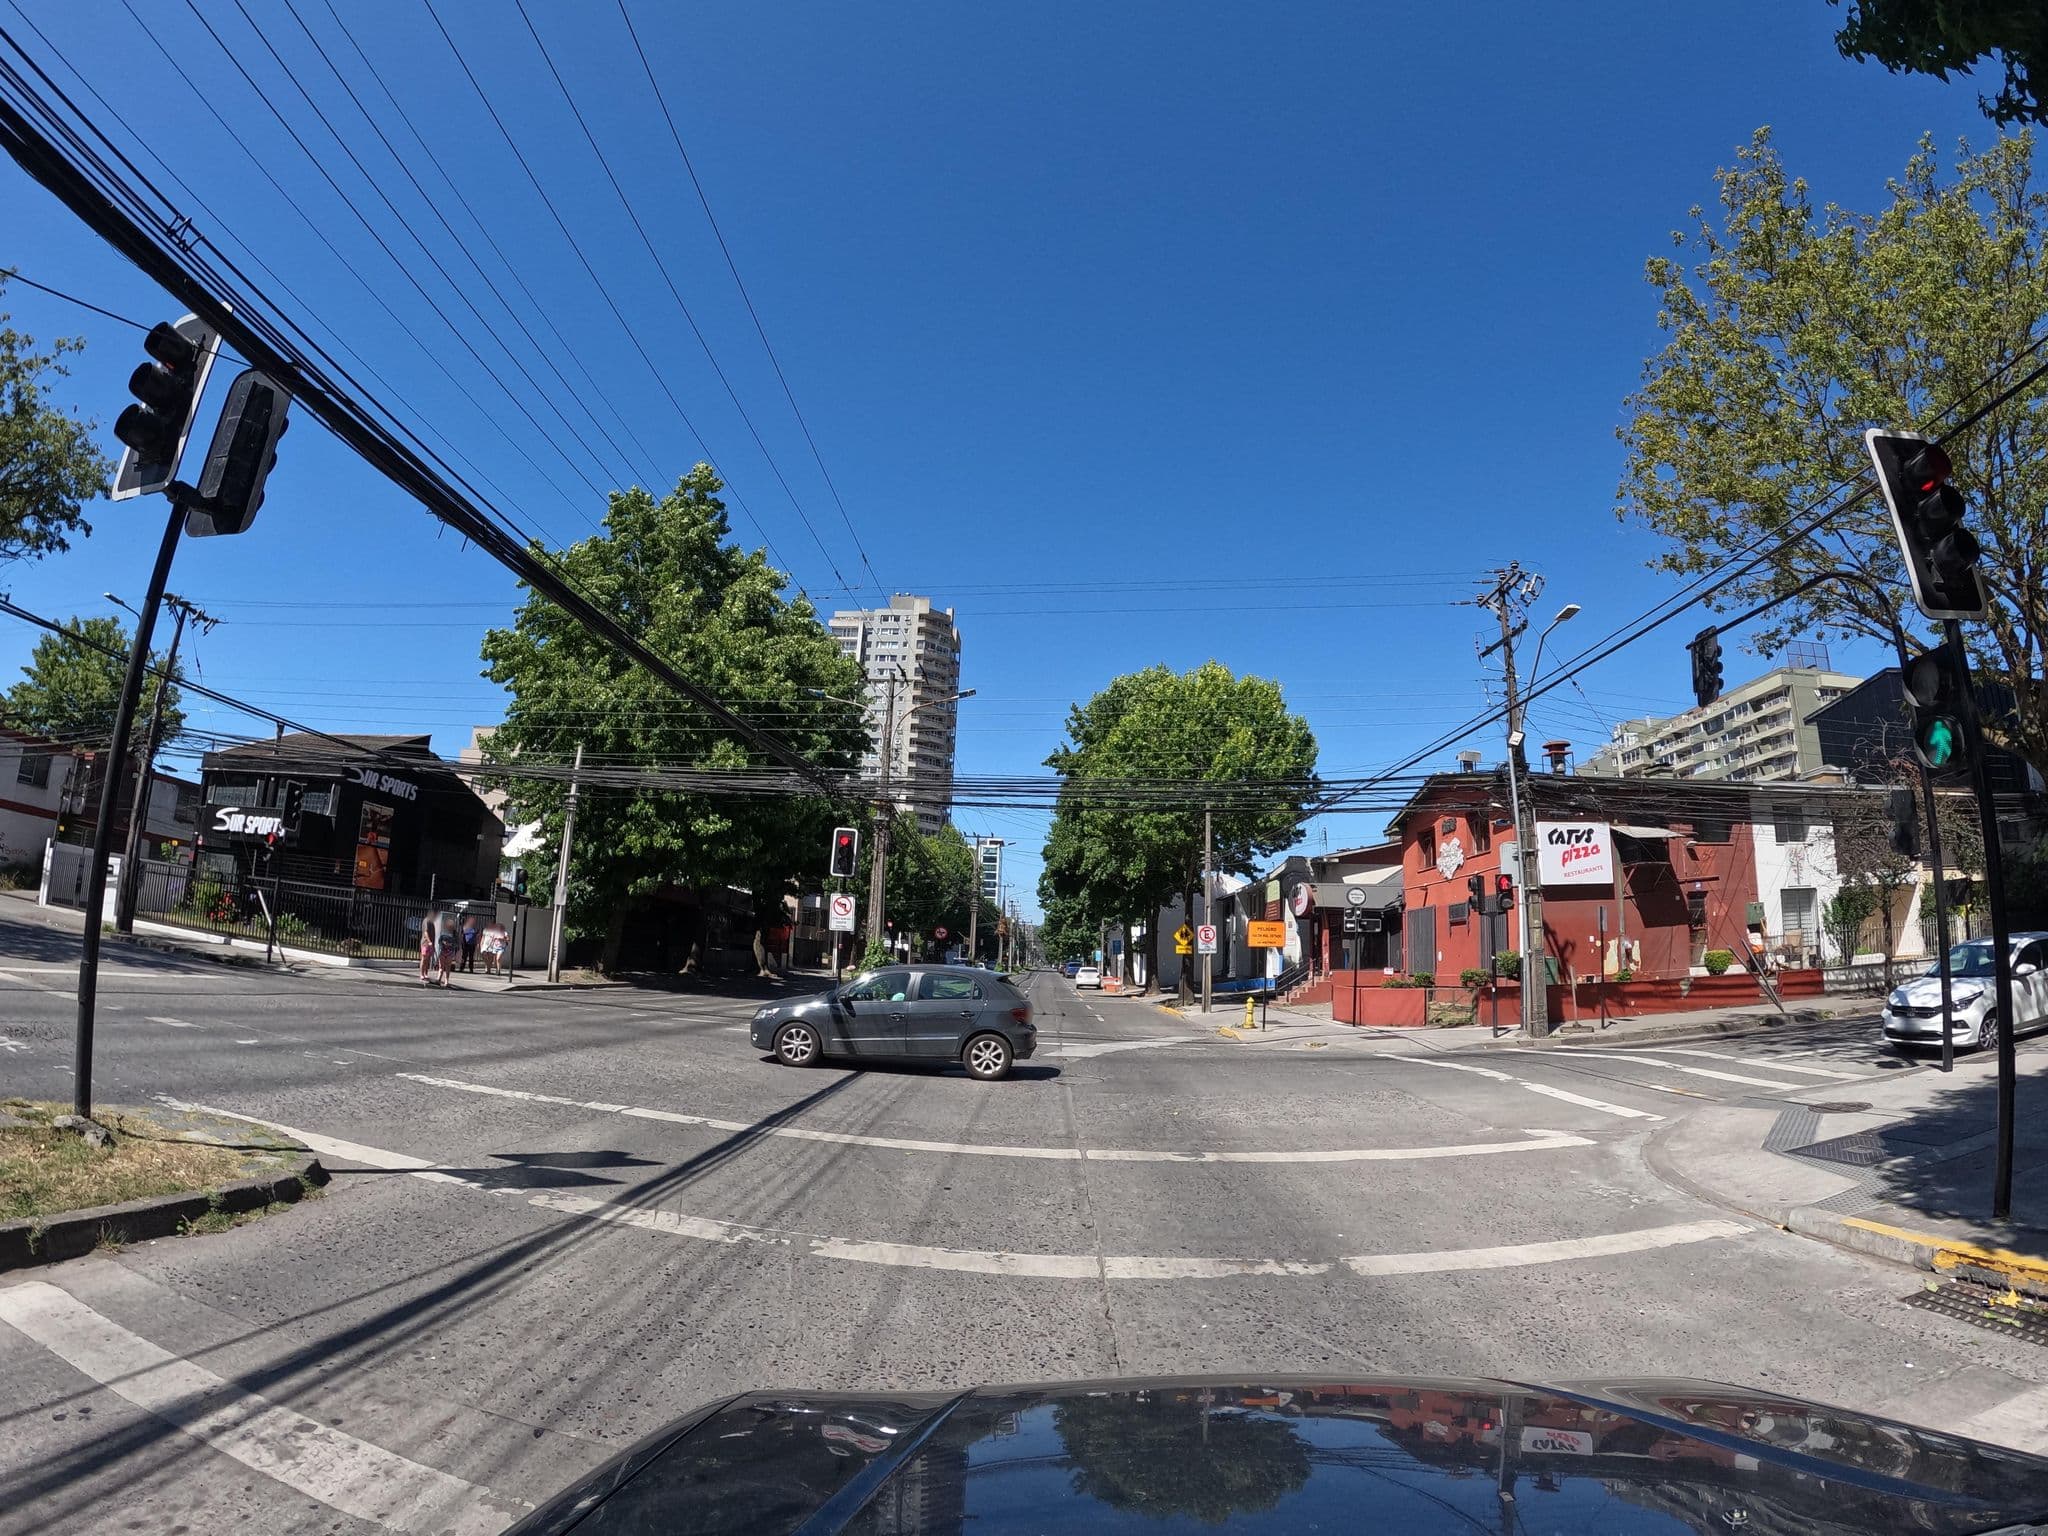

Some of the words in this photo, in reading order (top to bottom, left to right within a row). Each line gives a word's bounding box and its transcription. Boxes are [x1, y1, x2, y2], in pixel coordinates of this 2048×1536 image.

[379, 775, 418, 801] SPORTS
[212, 807, 246, 832] SUR
[244, 815, 286, 837] SPORTS
[1561, 844, 1600, 868] pizza
